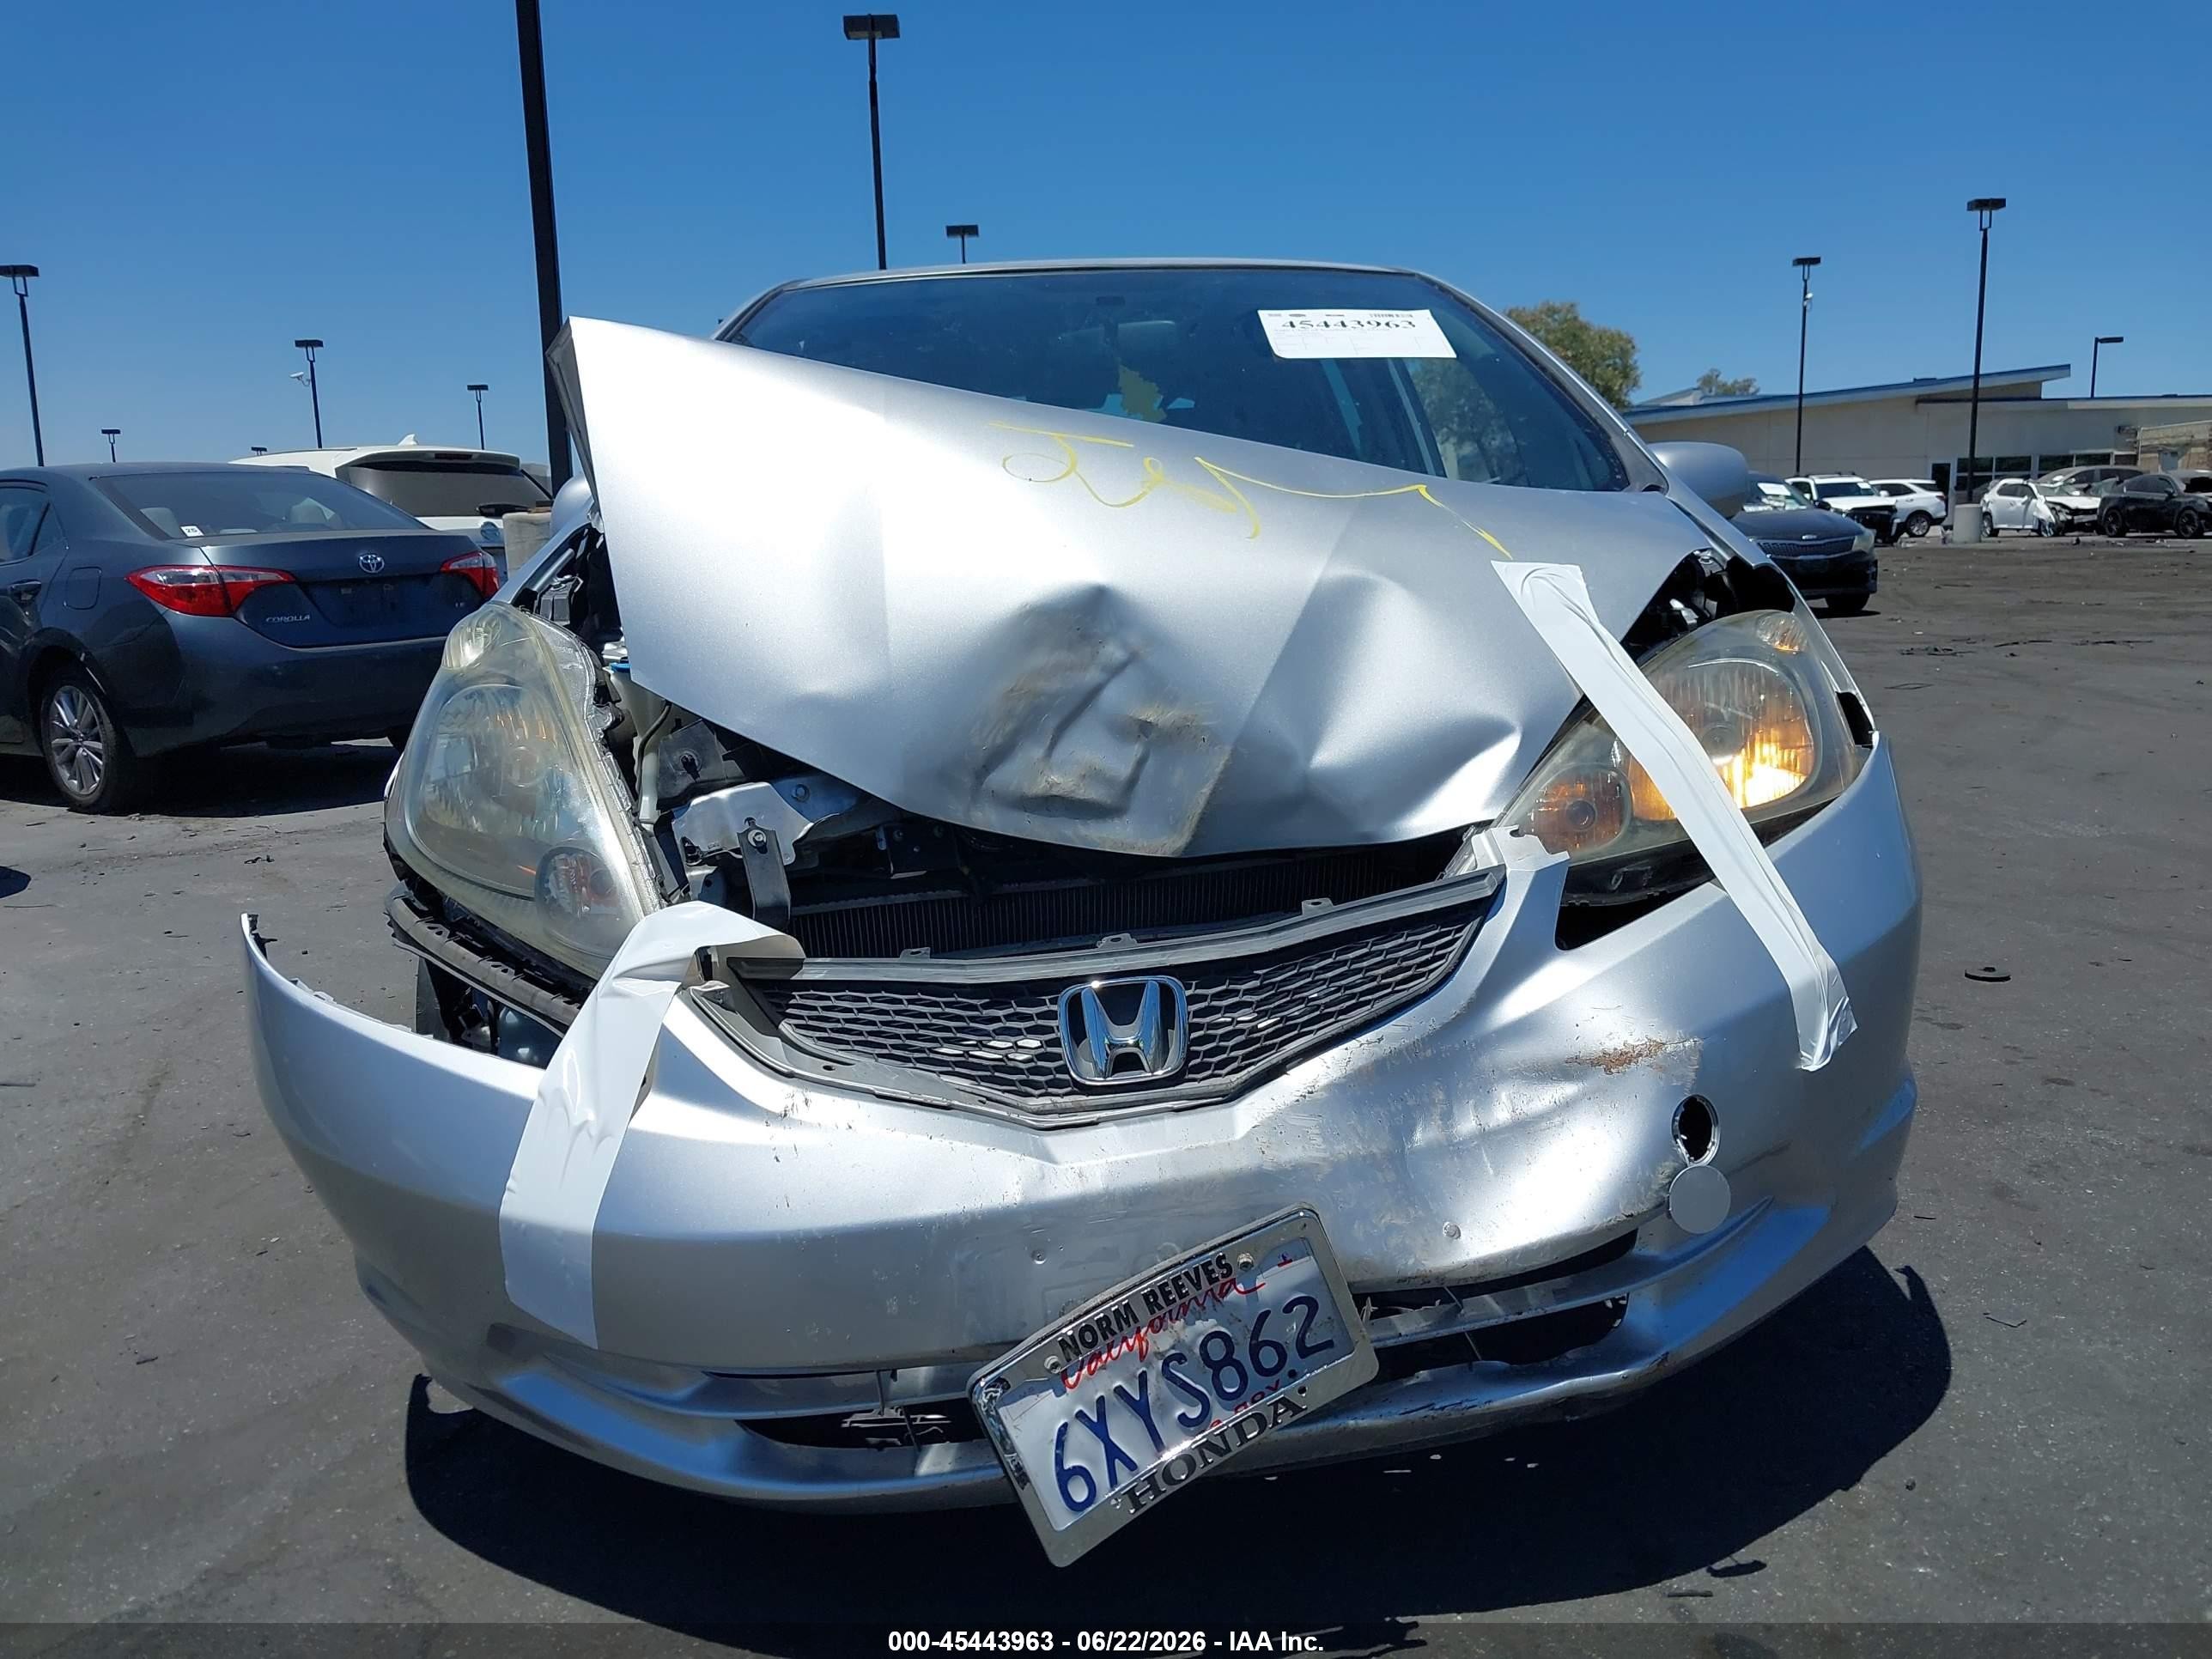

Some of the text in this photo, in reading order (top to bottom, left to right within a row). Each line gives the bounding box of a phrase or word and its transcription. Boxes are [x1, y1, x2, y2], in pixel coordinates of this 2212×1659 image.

[1283, 320, 1416, 329] 45443963
[265, 614, 310, 623] COROLLA
[1057, 1252, 1234, 1363] NORM REEVES
[1054, 1295, 1335, 1512] 6XYS862
[1123, 1393, 1308, 1516] HONDA
